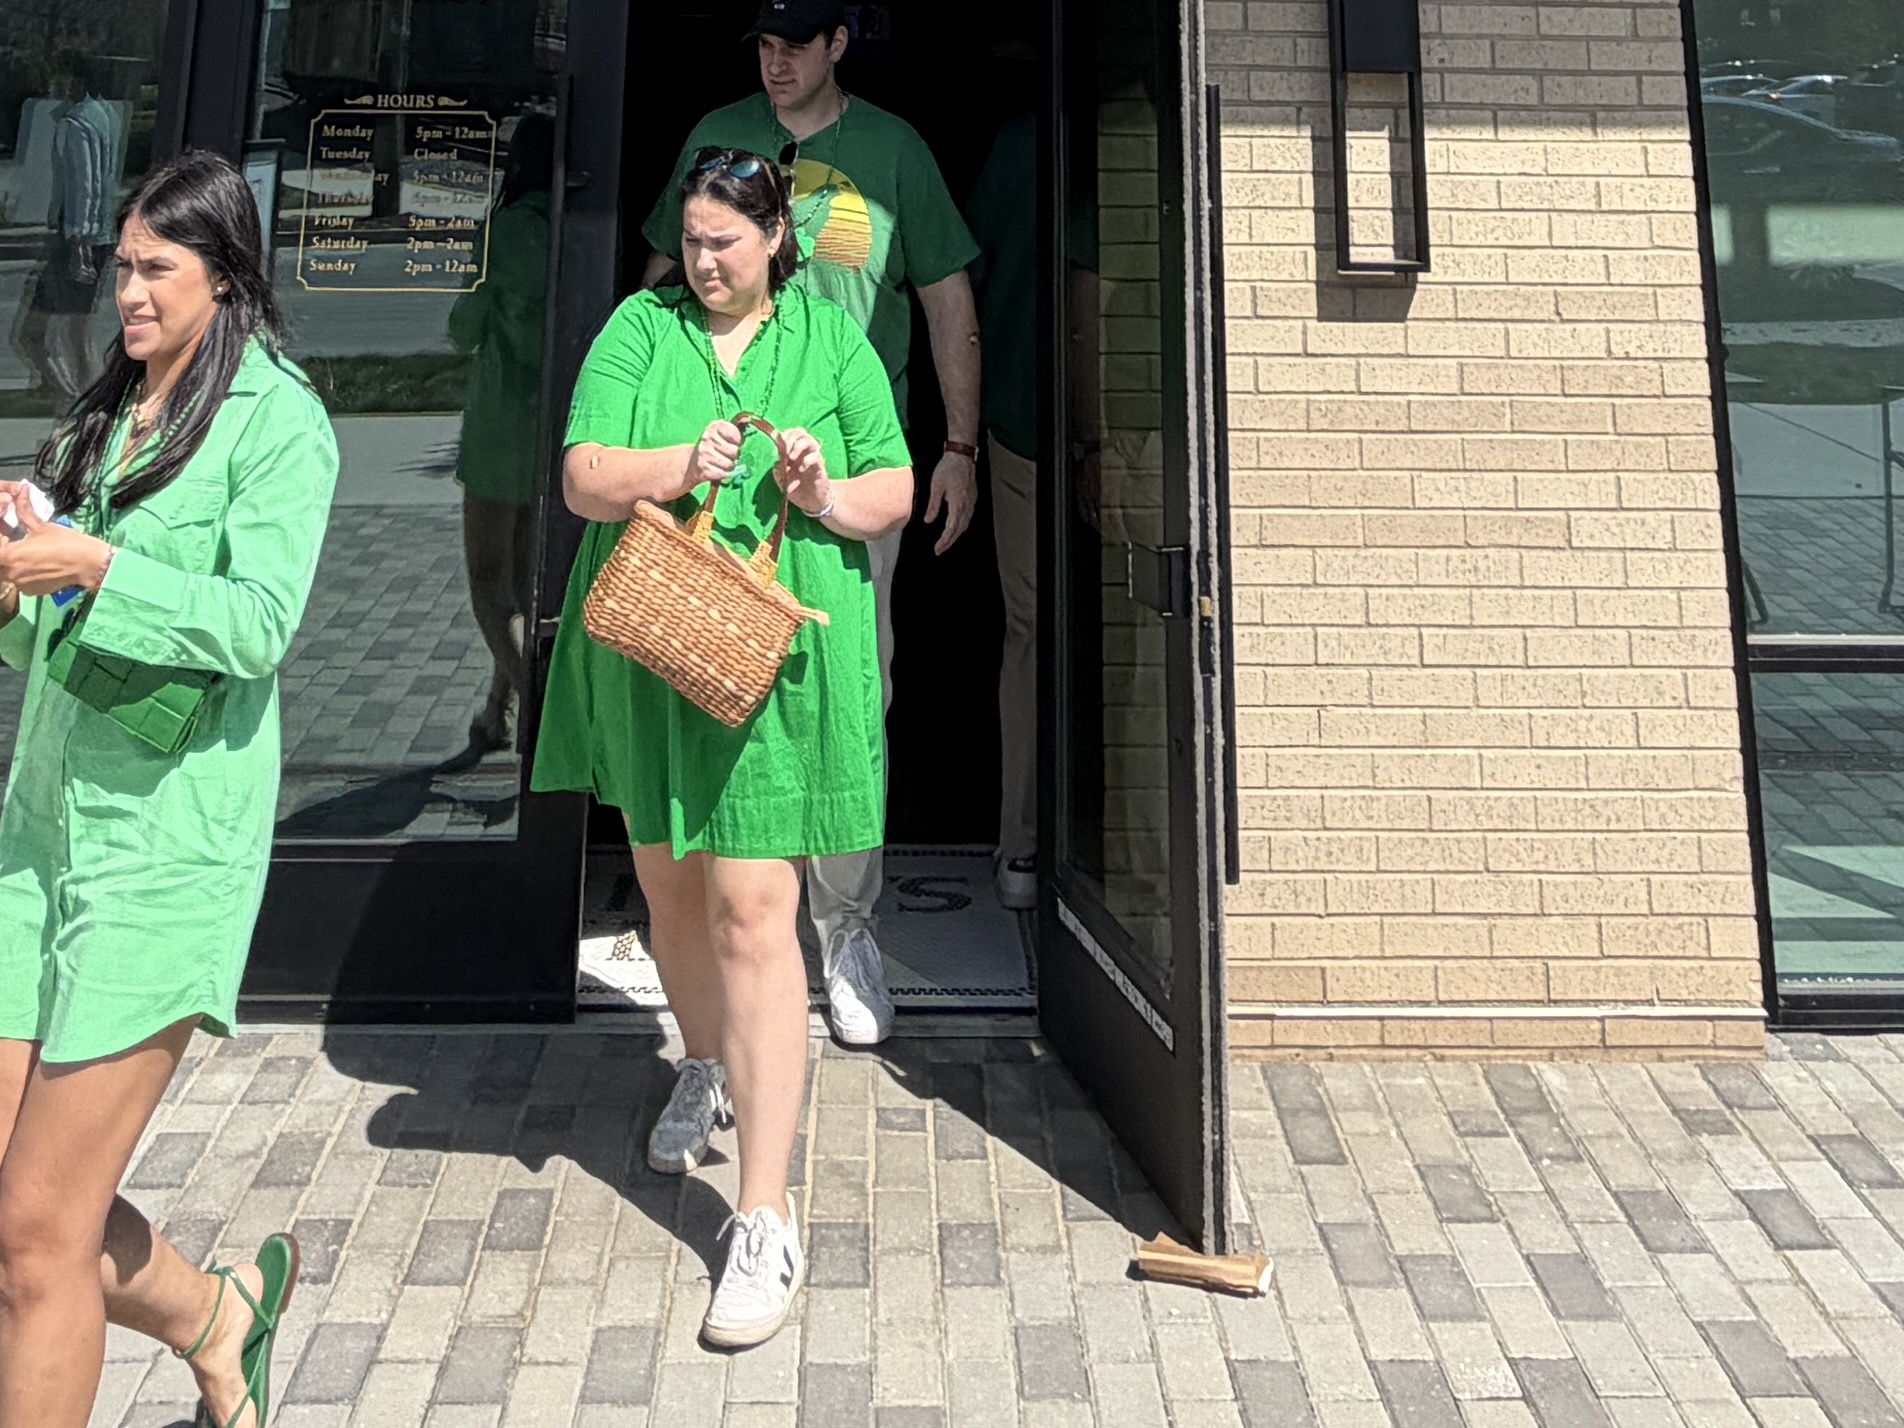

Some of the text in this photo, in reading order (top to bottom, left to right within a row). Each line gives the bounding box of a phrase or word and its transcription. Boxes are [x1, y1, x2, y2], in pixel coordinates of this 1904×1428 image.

[377, 94, 436, 108] HOURS
[322, 125, 375, 141] Monday
[415, 126, 443, 142] 5pm
[319, 146, 457, 162] Tuesday Closed
[312, 236, 368, 253] Saturday
[406, 236, 434, 253] 2pm
[447, 237, 474, 250] 2am
[309, 259, 356, 276] Sunday
[404, 259, 432, 276] 2pm
[445, 259, 478, 273] 12am
